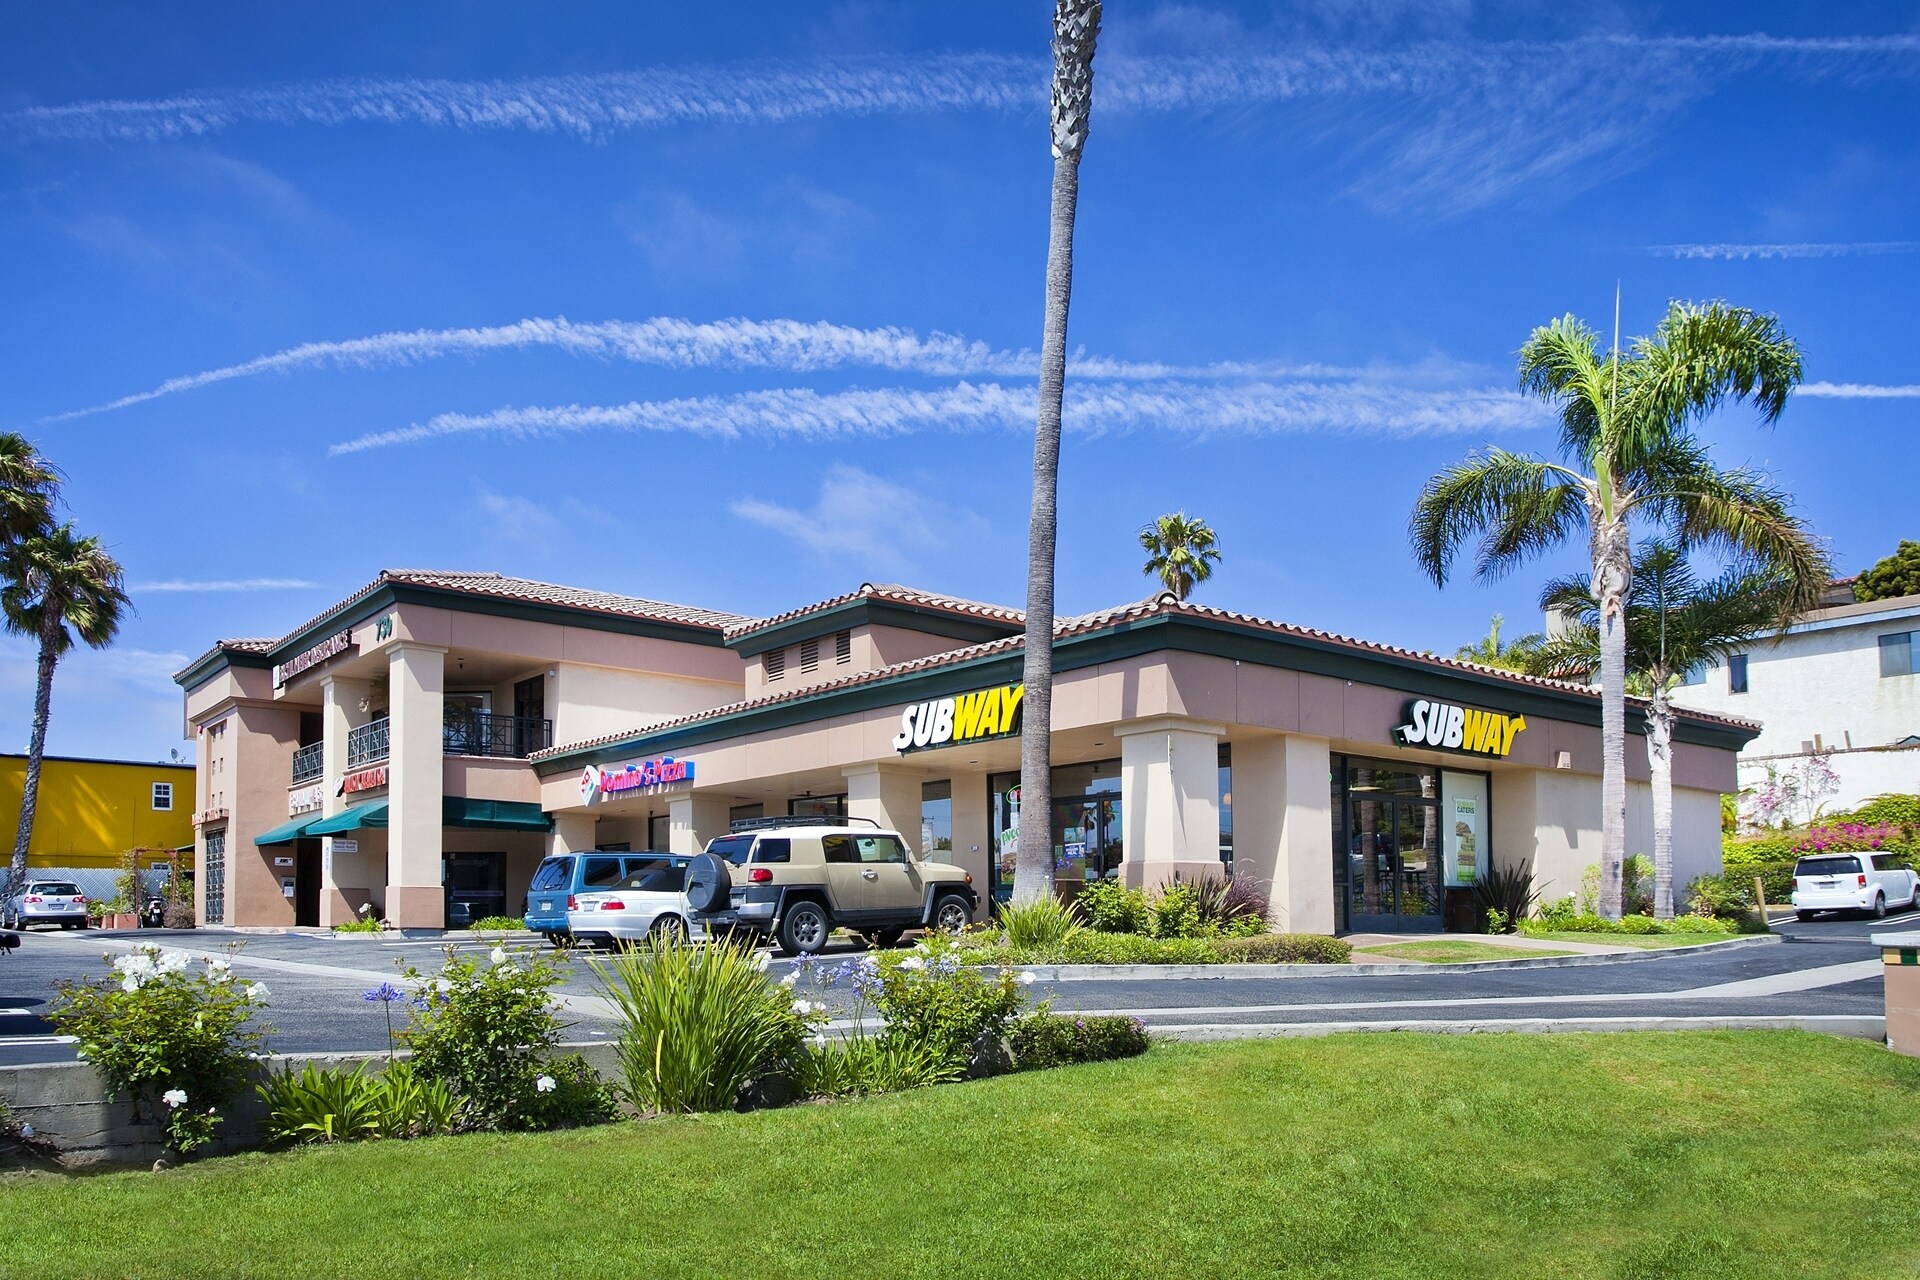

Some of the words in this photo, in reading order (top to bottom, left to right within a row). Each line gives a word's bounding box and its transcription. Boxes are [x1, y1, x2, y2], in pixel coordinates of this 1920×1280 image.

[376, 614, 393, 643] 730
[892, 684, 1024, 752] SUBWAY
[1403, 700, 1527, 756] SUBWAY
[599, 763, 651, 793] Domino's
[653, 757, 686, 784] Pizza
[1457, 806, 1475, 814] CATERS
